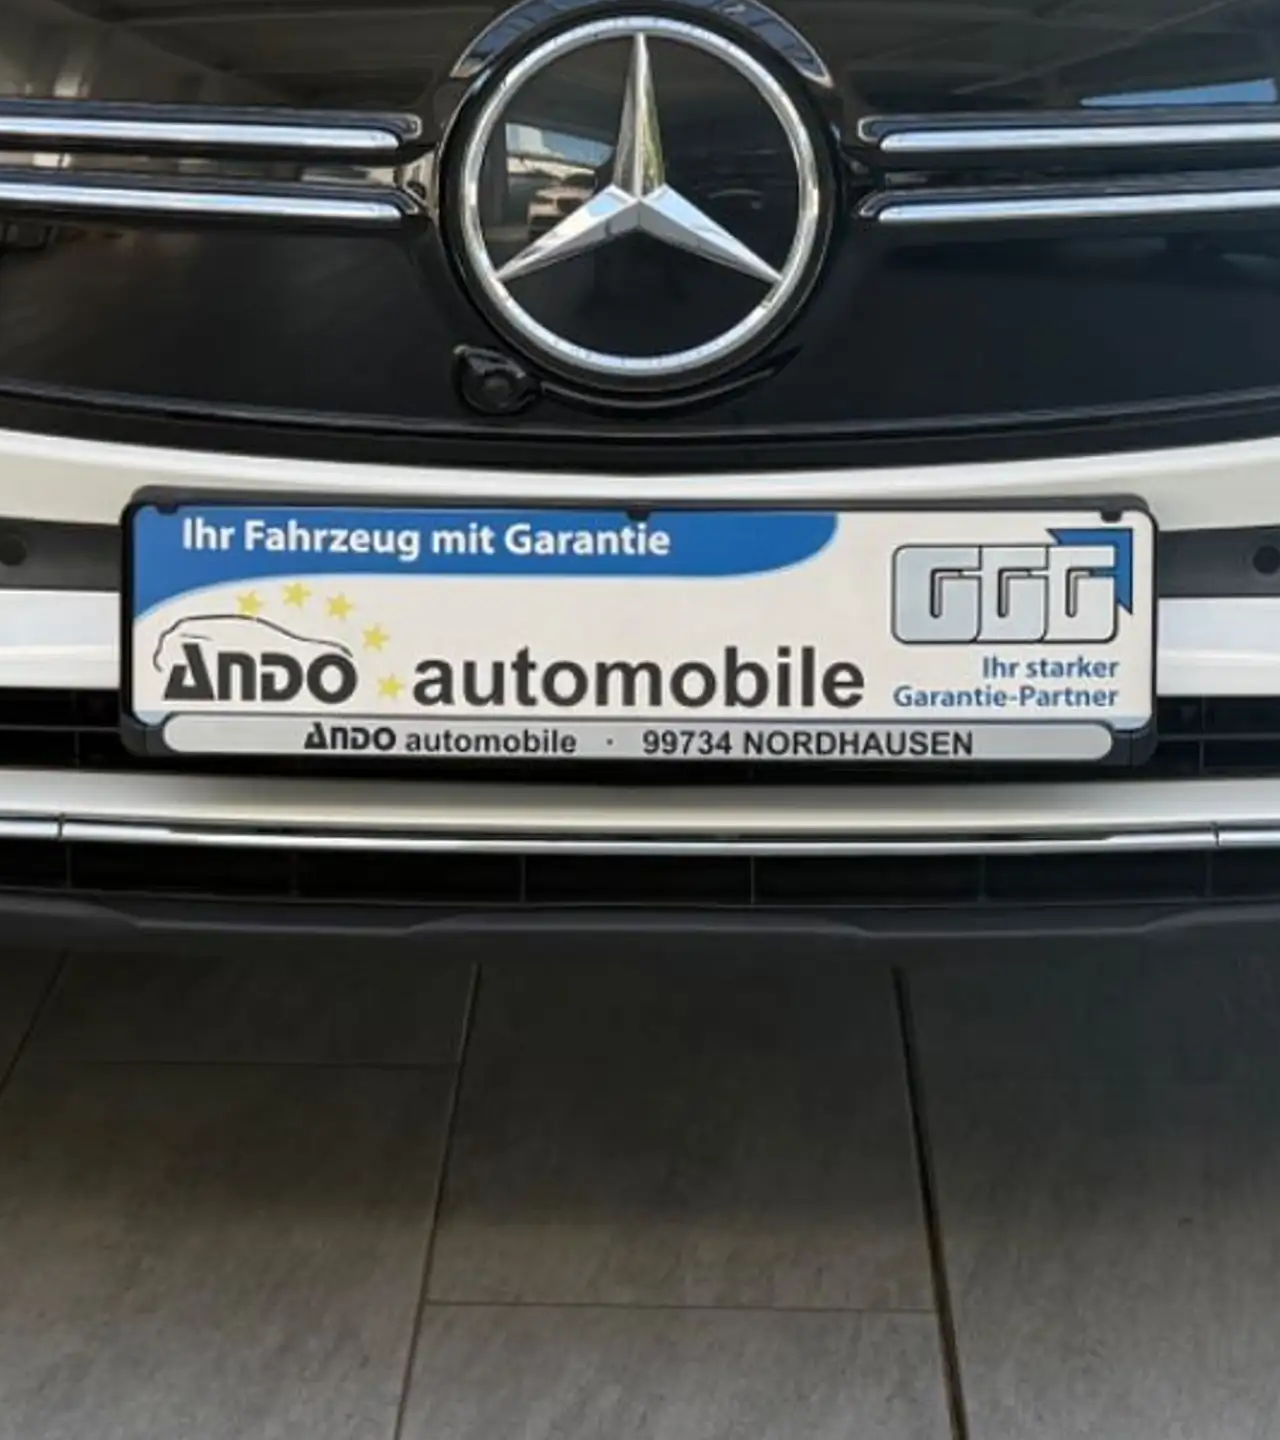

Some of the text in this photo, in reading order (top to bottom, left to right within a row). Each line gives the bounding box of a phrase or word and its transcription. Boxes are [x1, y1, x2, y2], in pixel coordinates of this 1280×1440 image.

[182, 517, 670, 561] Ihr Fahrzeug mit Garantie
[412, 645, 865, 709] automobile
[982, 656, 1119, 679] Ihr starker
[893, 685, 1119, 708] Garantie-Partner
[405, 728, 577, 754] automobile
[642, 730, 733, 755] 99734
[743, 731, 973, 756] NORDHAUSEN
